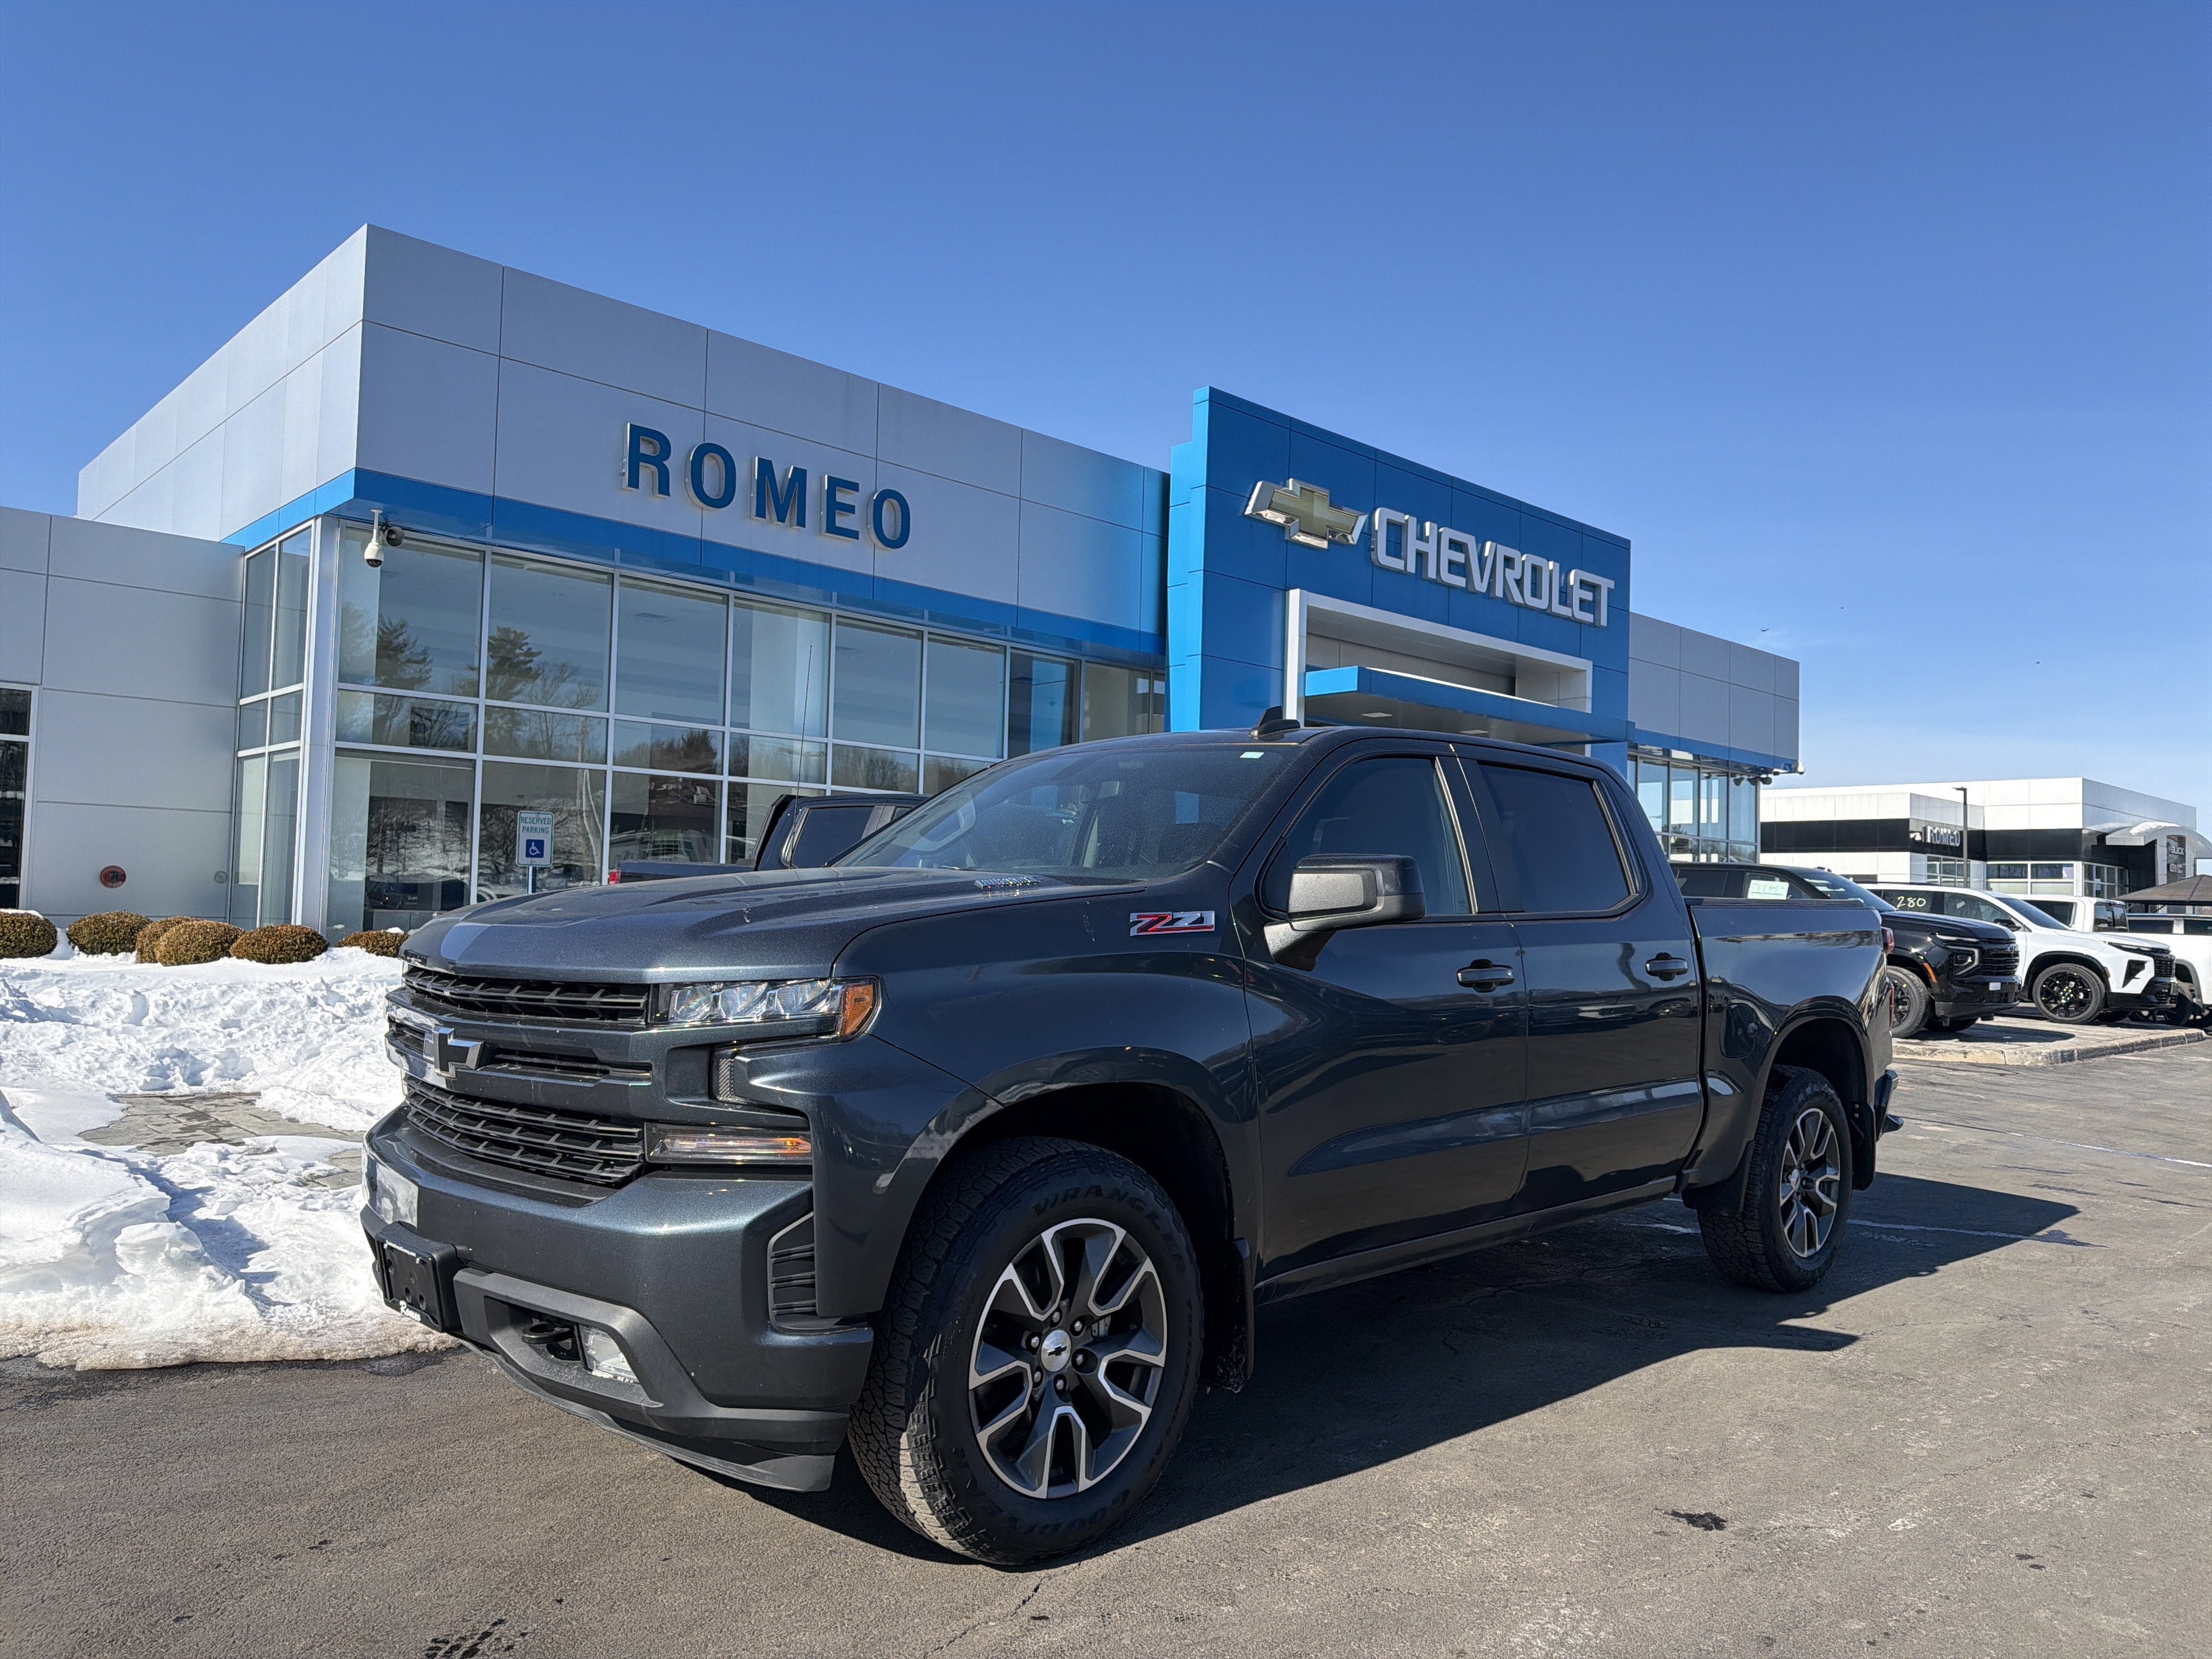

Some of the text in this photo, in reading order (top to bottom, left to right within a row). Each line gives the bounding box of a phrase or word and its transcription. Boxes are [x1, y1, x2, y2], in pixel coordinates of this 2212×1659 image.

[622, 422, 911, 549] ROMEO
[1372, 506, 1615, 627] CHEVROLET
[521, 816, 551, 825] RESERVED
[522, 826, 549, 834] PARKING
[1927, 826, 1961, 847] ROMEO
[1897, 896, 1926, 908] 280
[1130, 911, 1215, 936] Z71
